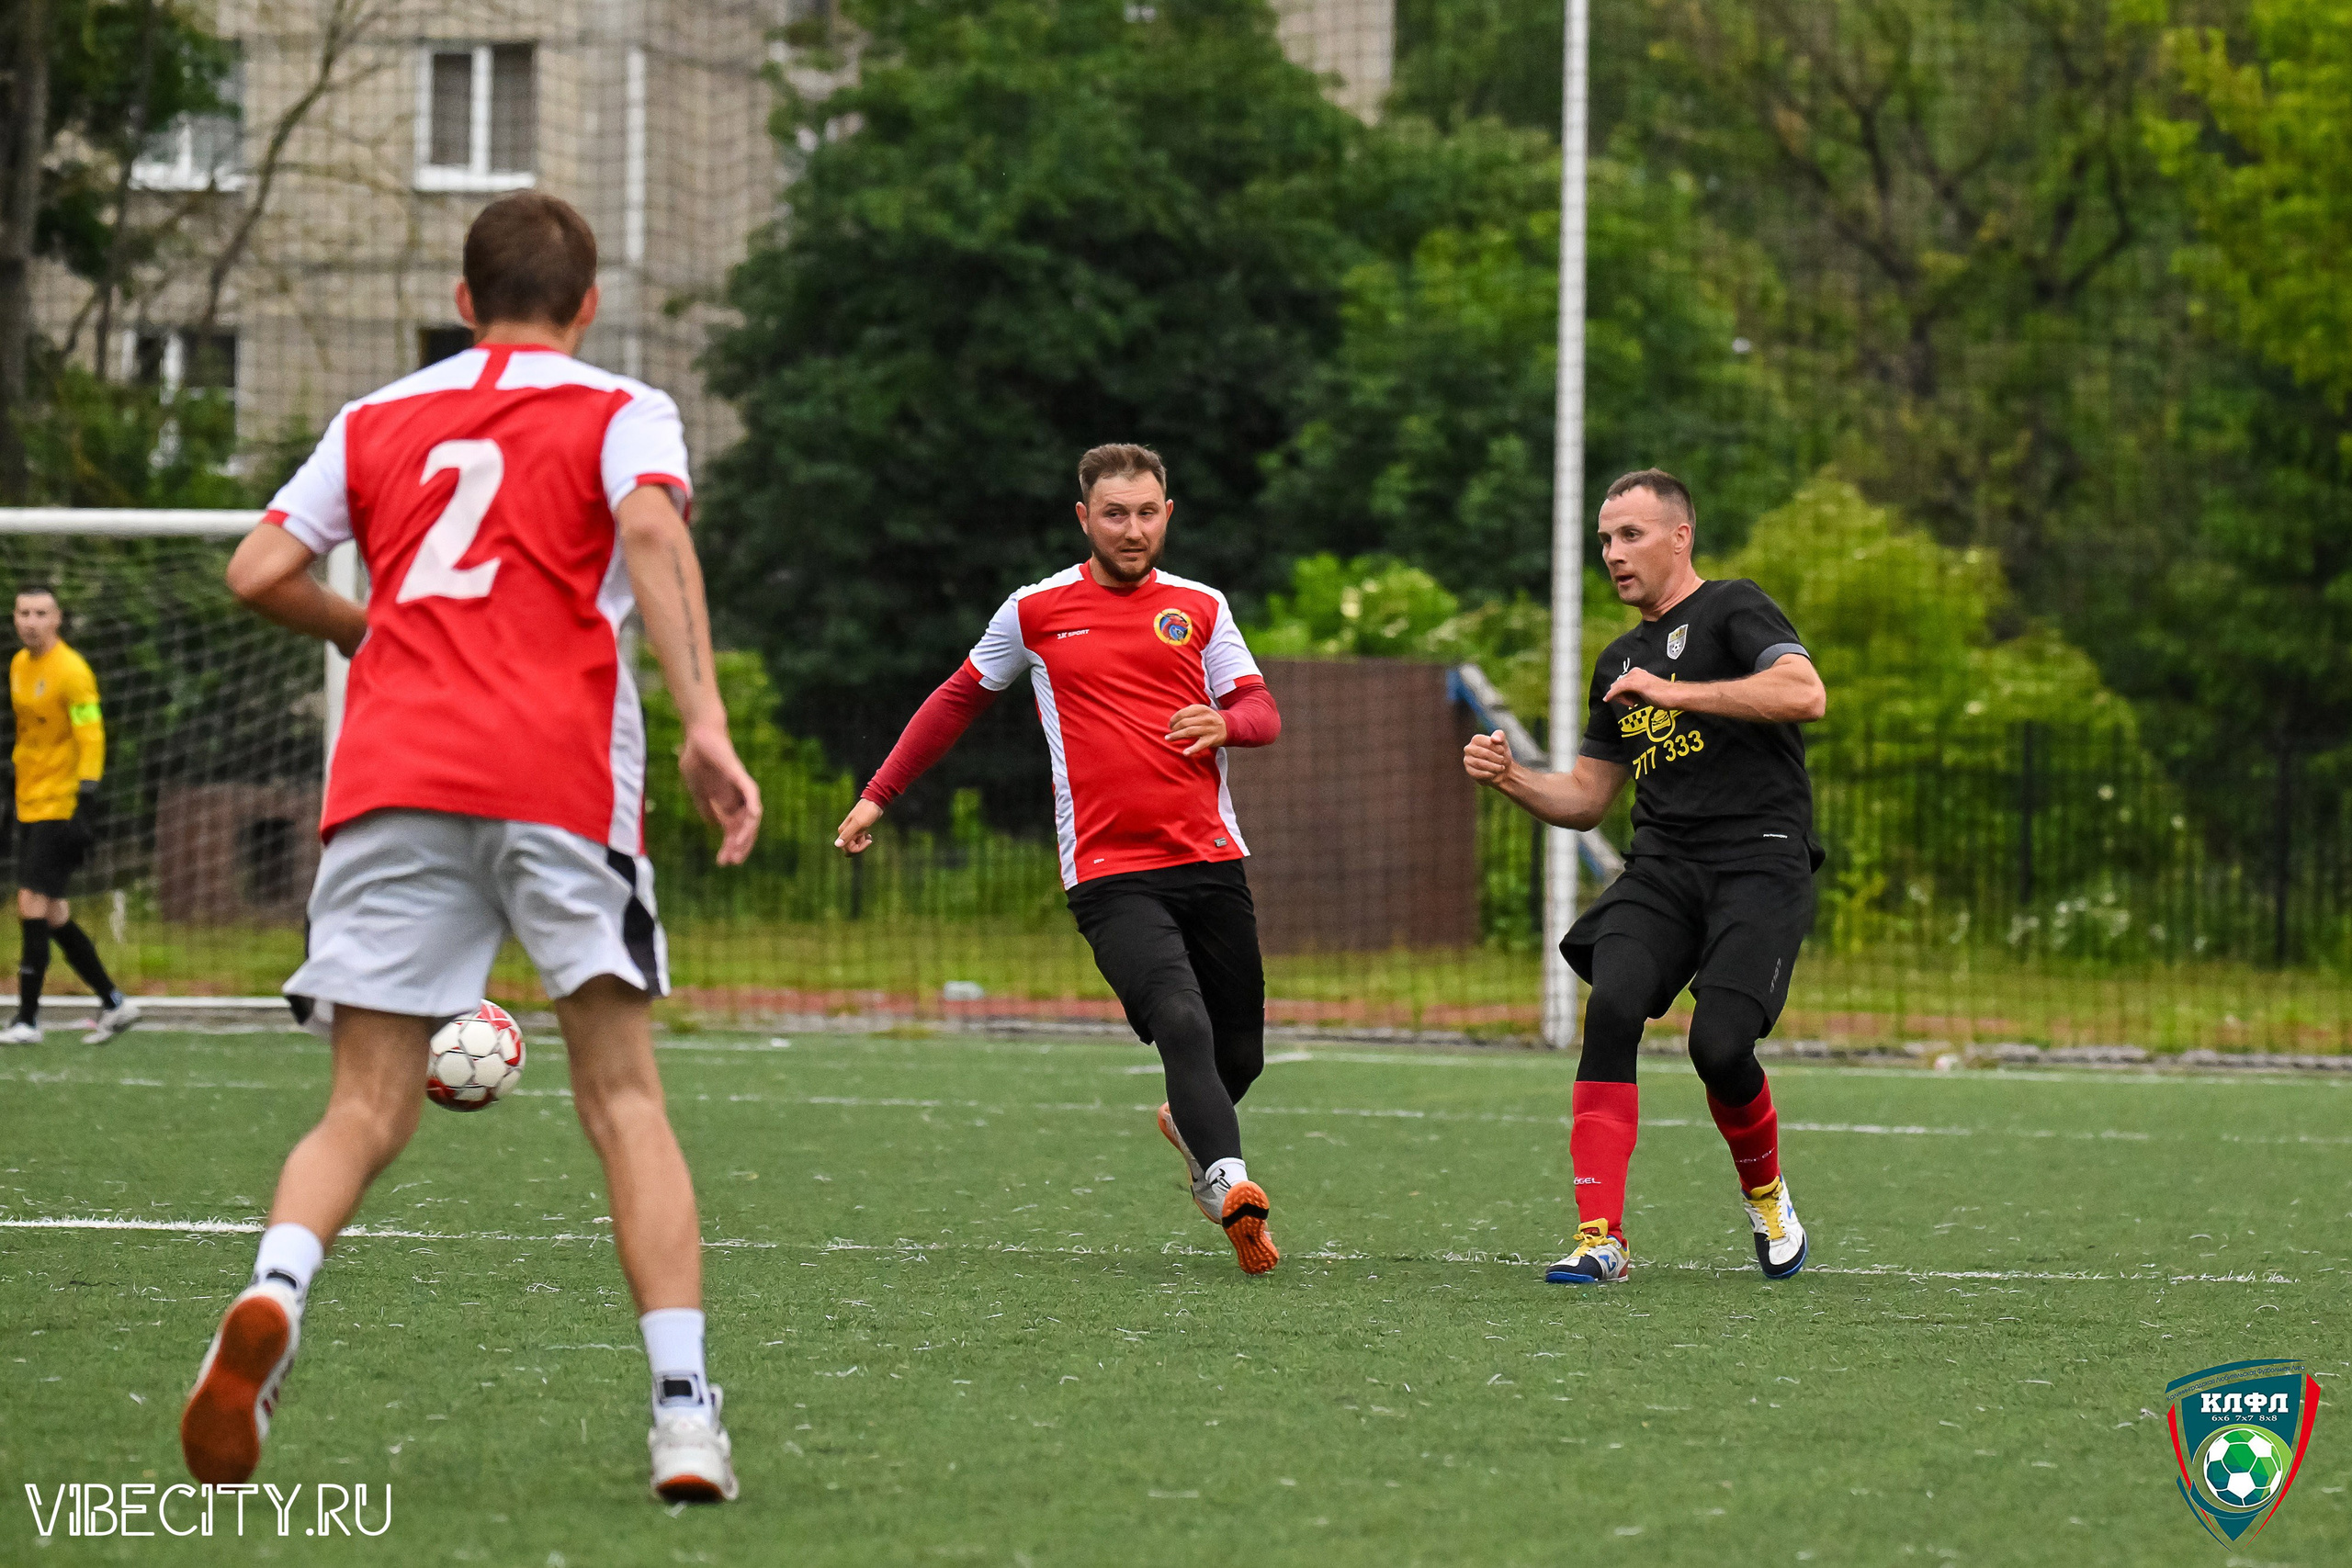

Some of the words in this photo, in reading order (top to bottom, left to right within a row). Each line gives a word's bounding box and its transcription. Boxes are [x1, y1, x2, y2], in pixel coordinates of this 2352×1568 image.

[396, 438, 504, 604] 2
[1632, 745, 1657, 780] 777
[1663, 729, 1704, 761] 333
